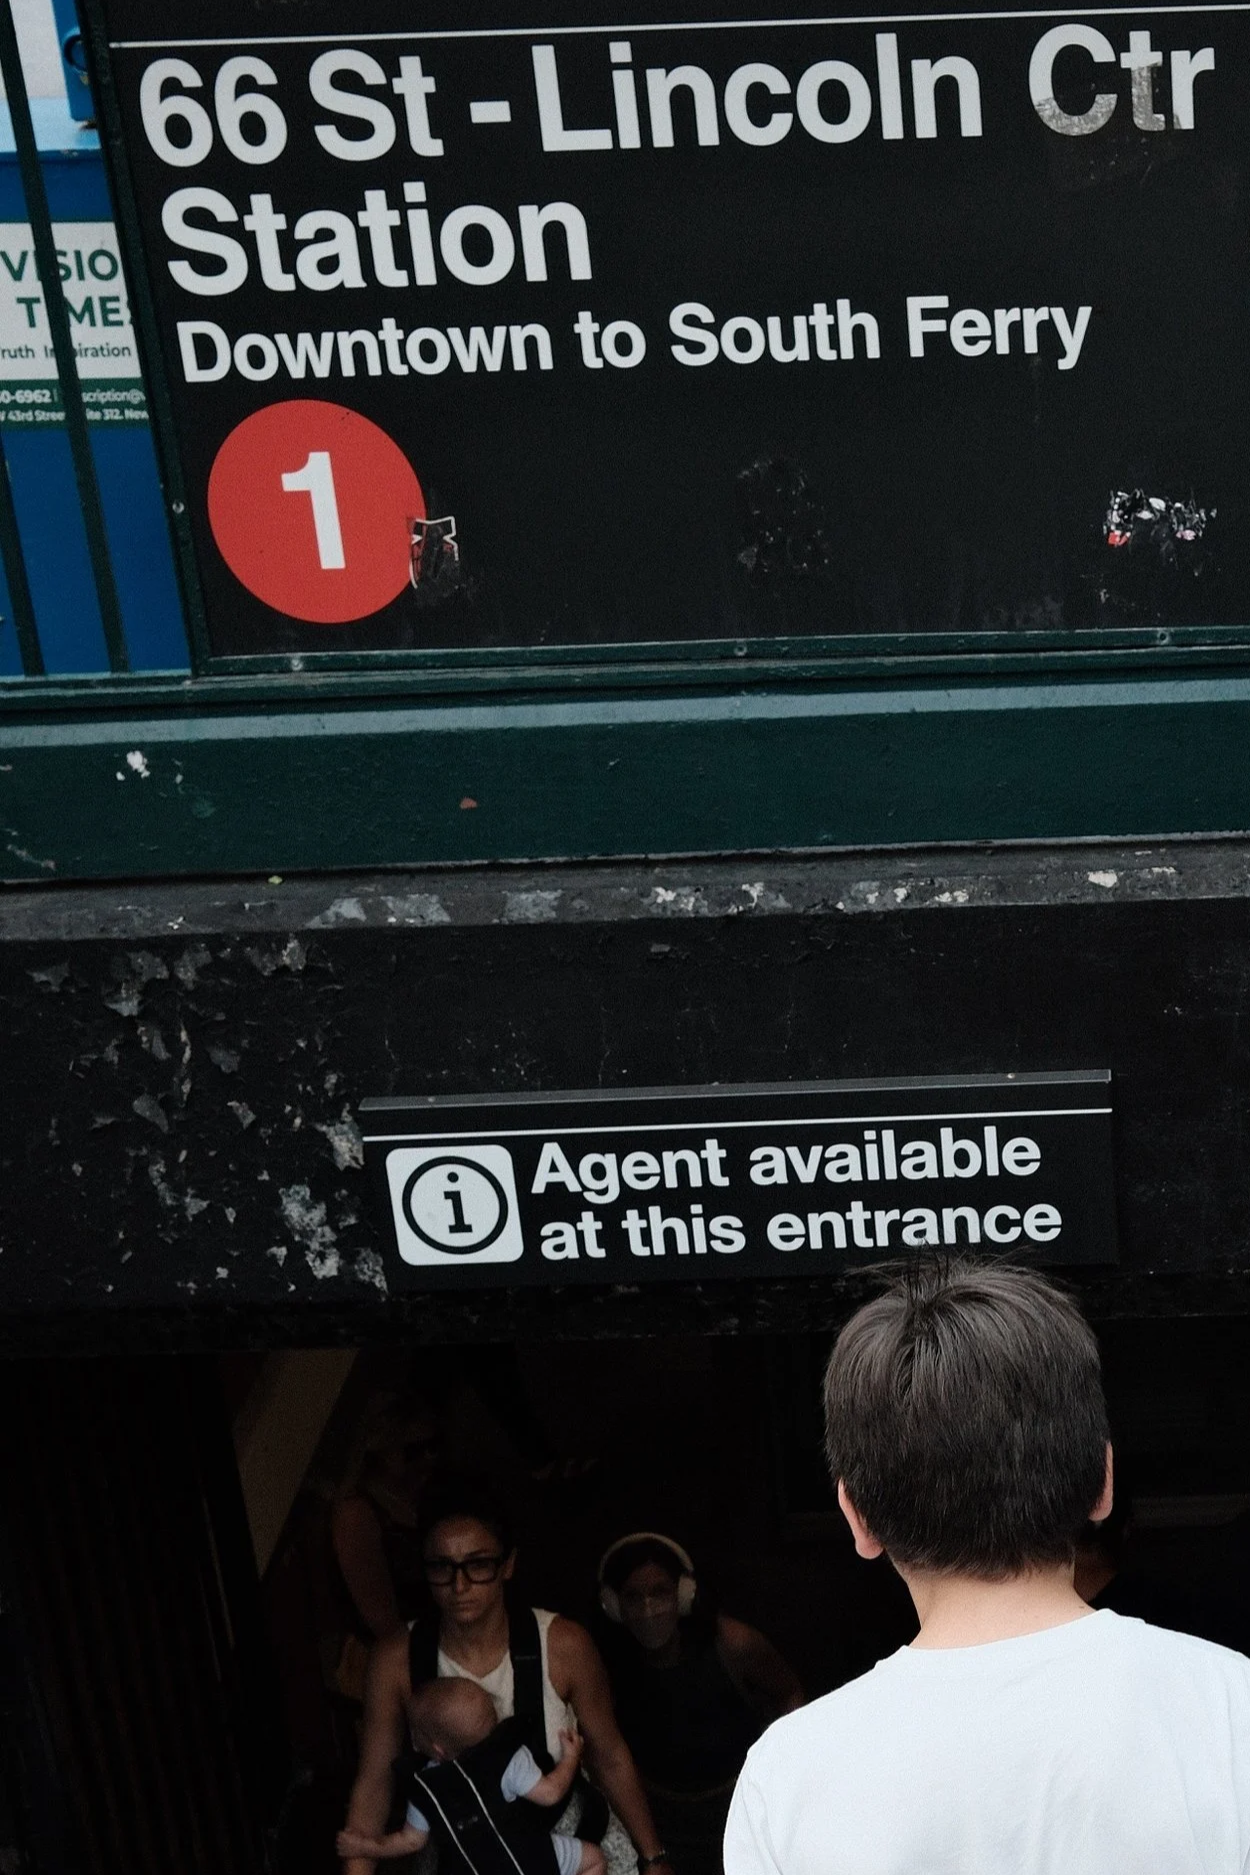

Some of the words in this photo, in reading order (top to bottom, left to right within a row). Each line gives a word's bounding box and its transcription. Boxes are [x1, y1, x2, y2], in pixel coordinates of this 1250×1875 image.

[139, 55, 288, 168] 66
[308, 48, 445, 162] St
[531, 32, 983, 152] Lincoln
[1028, 23, 1216, 136] Ctr
[161, 181, 593, 296] Station
[16, 295, 124, 328] TME
[176, 317, 554, 382] Downtown
[573, 310, 647, 369] to
[668, 298, 881, 367] South
[906, 295, 1093, 371] Ferry
[280, 450, 347, 570] 1
[530, 1138, 730, 1205] Agent
[749, 1125, 1042, 1186] available
[540, 1210, 607, 1261] at
[620, 1203, 746, 1257] this
[766, 1200, 1063, 1252] entrance
